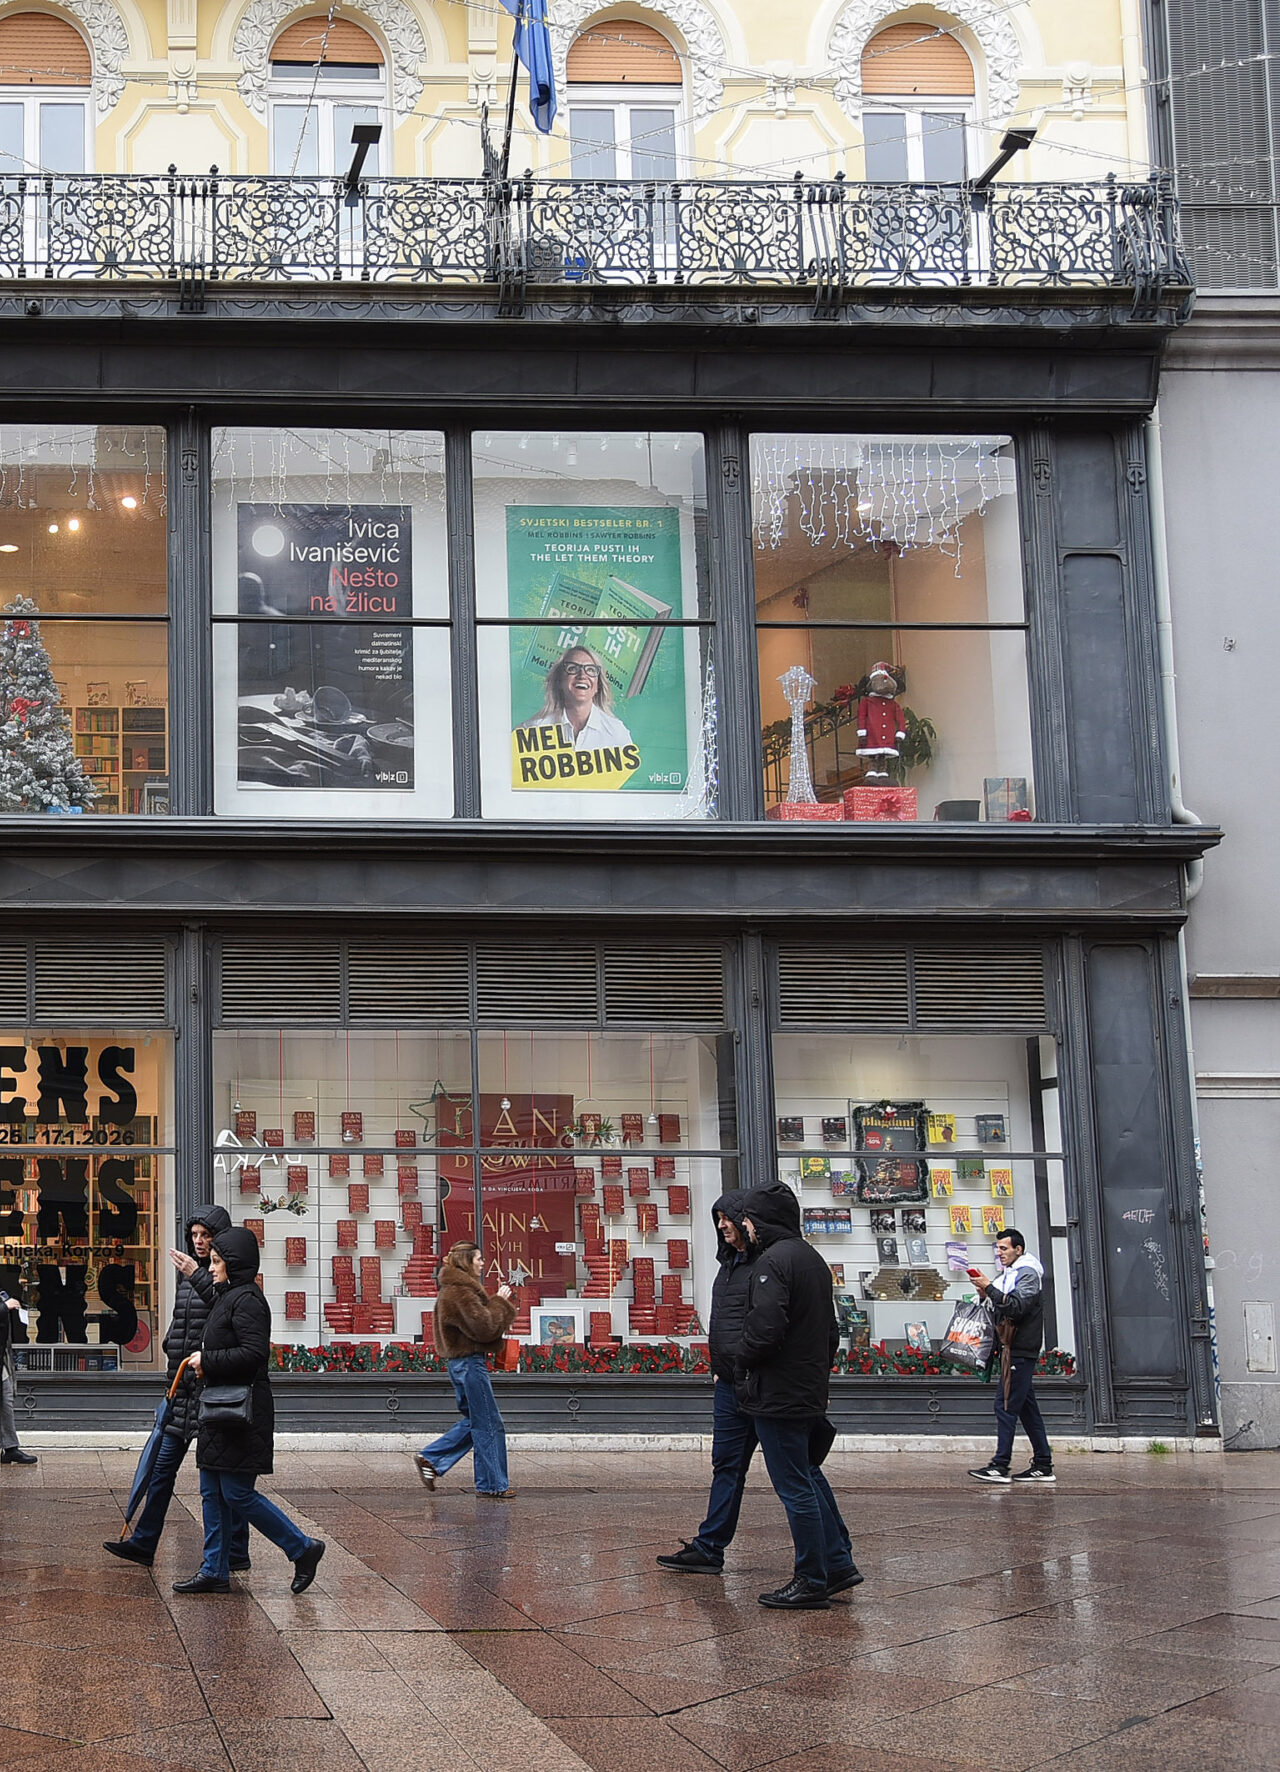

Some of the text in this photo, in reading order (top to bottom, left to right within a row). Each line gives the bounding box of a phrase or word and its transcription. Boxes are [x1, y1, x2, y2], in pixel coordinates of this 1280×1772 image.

[348, 518, 400, 539] Ivica
[520, 518, 664, 528] SVJETSKI BESTSELER BR. 1
[290, 541, 400, 563] Ivanišević
[530, 554, 655, 563] THE LET THEM THEORY
[545, 544, 590, 552] TEORIJA
[594, 544, 624, 552] PUSTI
[331, 567, 399, 588] Nešto
[310, 591, 396, 613] na žlicu
[531, 656, 548, 668] Mel
[516, 724, 572, 754] MEL
[520, 745, 640, 782] ROBBINS
[4, 1244, 58, 1259] Rijeka,
[62, 1244, 112, 1257] Korzo
[115, 1244, 124, 1257] 9
[490, 1241, 522, 1252] SVIH
[486, 1258, 544, 1279] AJNI
